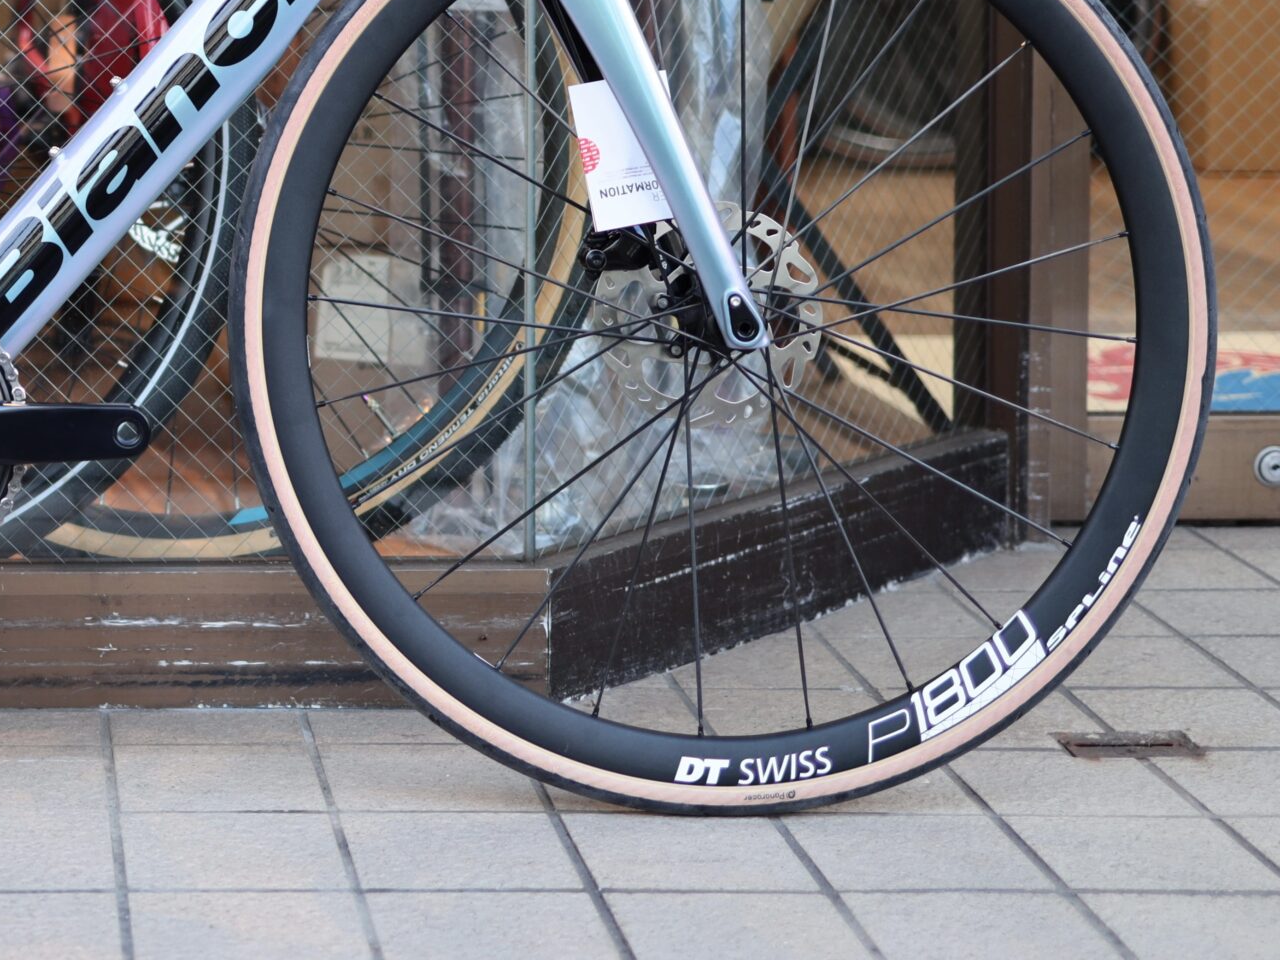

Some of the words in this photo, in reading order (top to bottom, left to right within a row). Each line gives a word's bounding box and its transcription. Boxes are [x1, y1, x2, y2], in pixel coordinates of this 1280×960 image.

[599, 179, 660, 200] ORMATION
[419, 407, 475, 461] TERRENO
[673, 756, 731, 785] DT
[737, 746, 833, 786] SWISS
[743, 791, 786, 801] Panaracer
